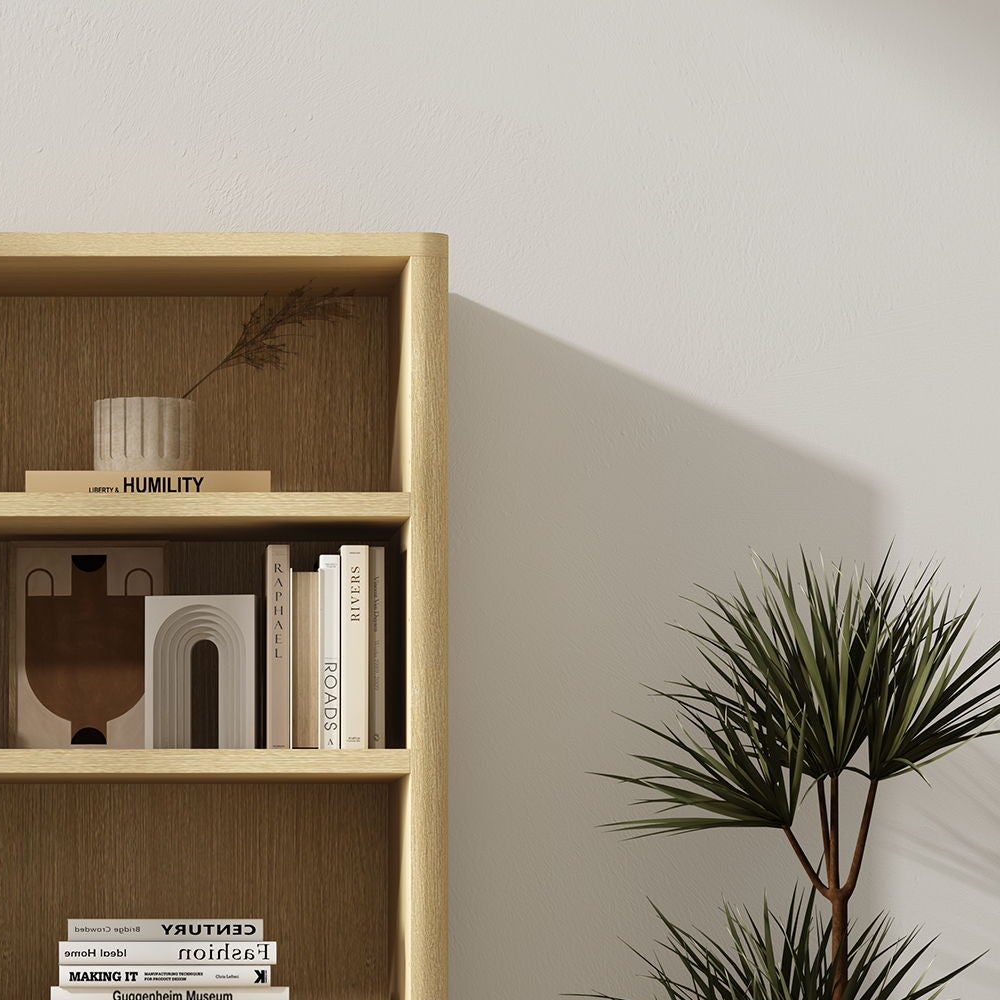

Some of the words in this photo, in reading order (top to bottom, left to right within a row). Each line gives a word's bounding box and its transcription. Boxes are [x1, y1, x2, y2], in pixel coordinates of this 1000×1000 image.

[122, 476, 205, 493] HUMILITY
[273, 562, 284, 659] RAPHAEL
[350, 565, 361, 622] RIVERS
[323, 662, 338, 731] ROADS
[69, 972, 122, 982] MAKING
[125, 972, 139, 982] IT
